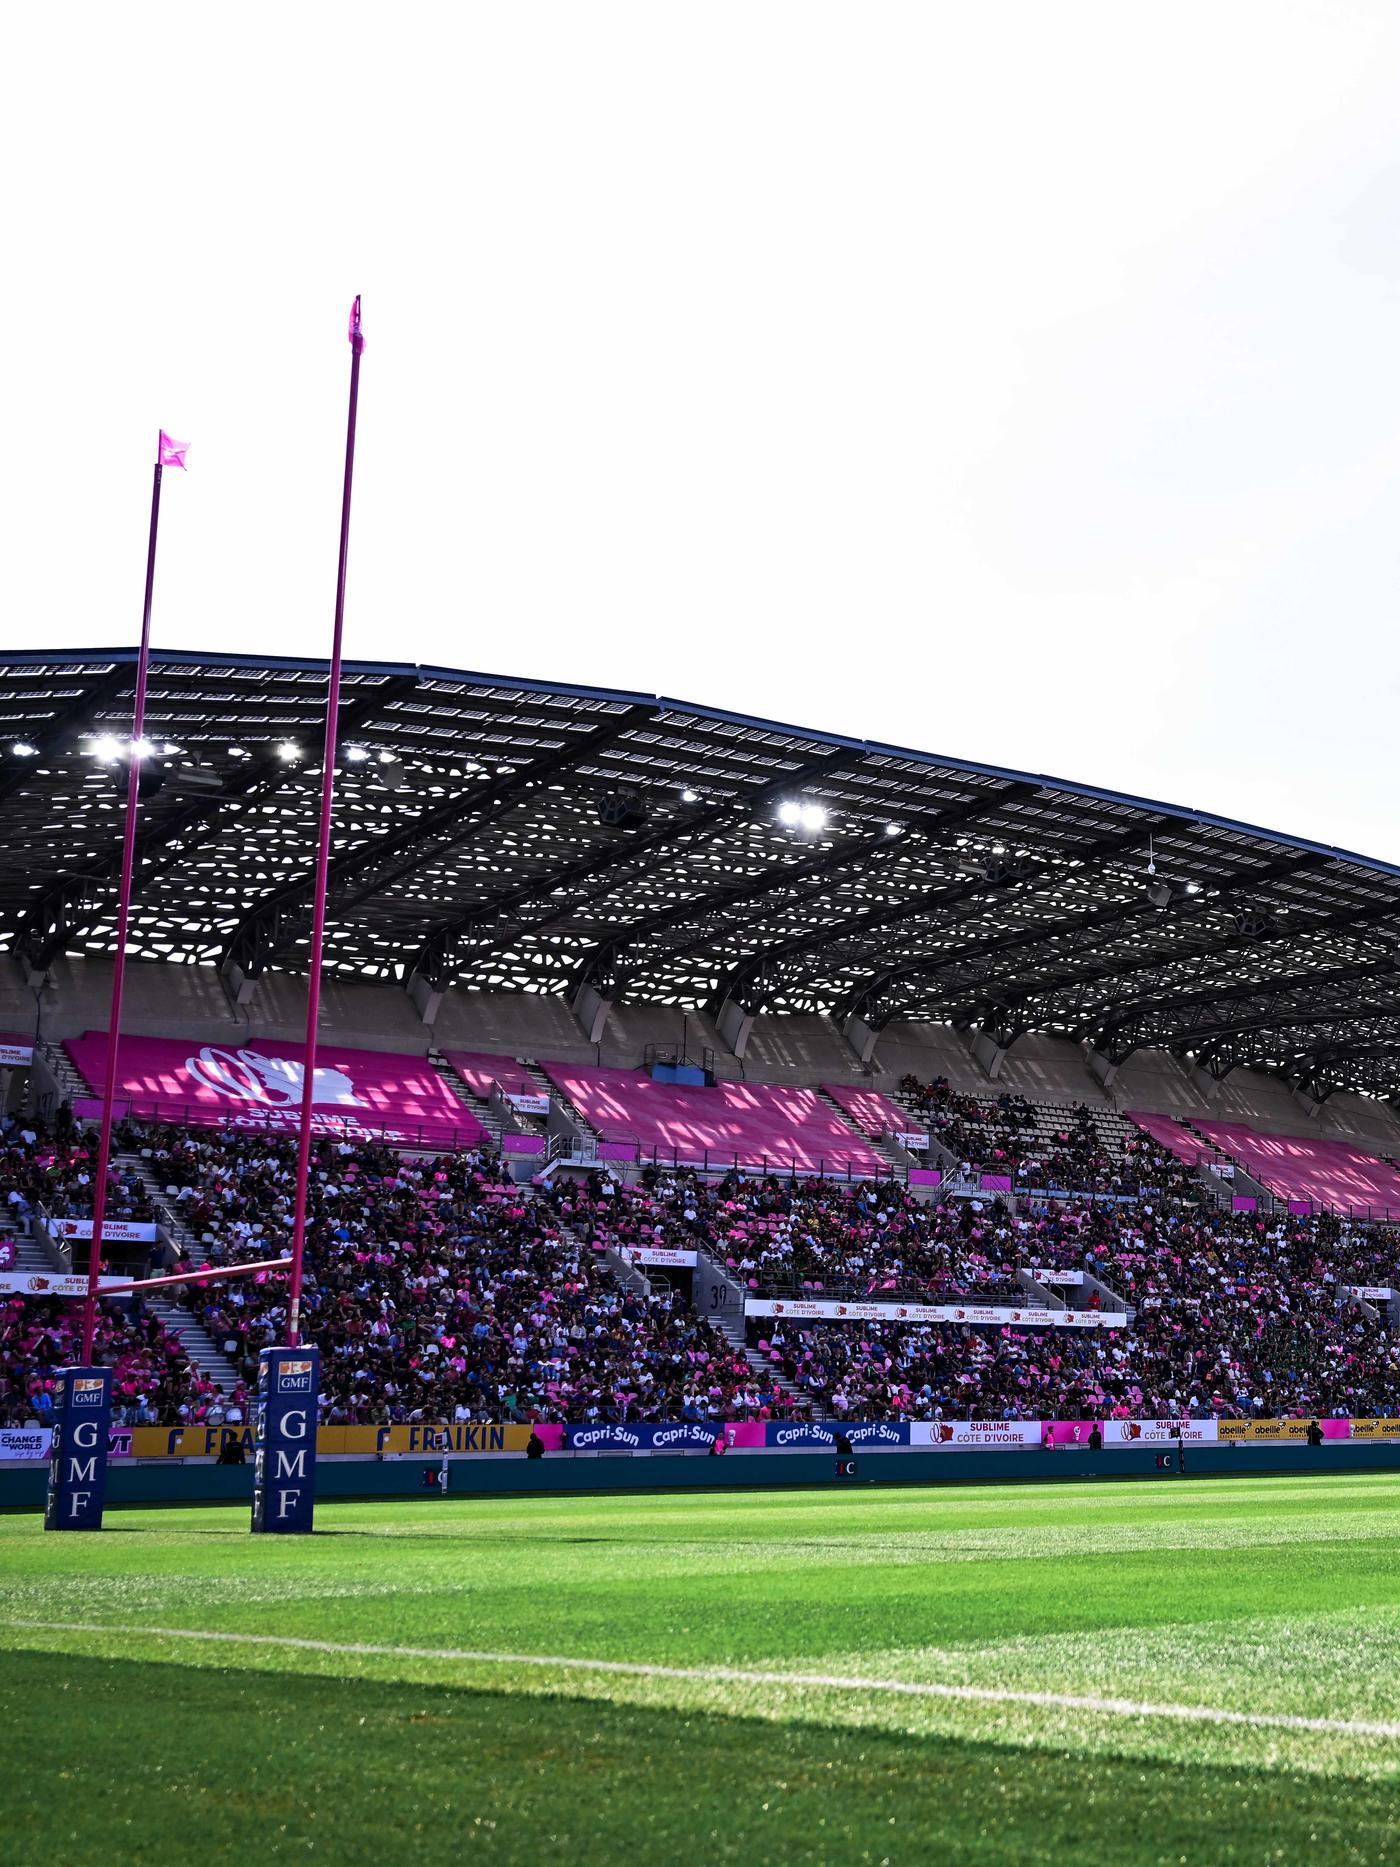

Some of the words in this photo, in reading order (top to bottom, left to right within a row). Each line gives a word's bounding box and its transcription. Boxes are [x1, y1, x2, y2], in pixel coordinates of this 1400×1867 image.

[104, 1231, 142, 1239] D'IVOIRE
[281, 1377, 310, 1389] GMF
[75, 1393, 101, 1403] GMF
[969, 1422, 1010, 1432] SUBLIME
[1155, 1421, 1191, 1429] SUBLIME
[1219, 1426, 1247, 1434] abeille
[1254, 1425, 1281, 1434] abeille
[409, 1426, 505, 1451] FRAIKIN
[573, 1425, 640, 1448] Capri-Sun
[652, 1423, 716, 1448] Capri-Sun
[776, 1423, 834, 1445] Capri-Sun
[845, 1423, 901, 1444] Capri-Sun
[956, 1431, 982, 1443] CÔTE
[984, 1433, 1024, 1443] D'IVOIRE
[1144, 1429, 1166, 1440] CÔTE
[67, 1422, 98, 1517] GMF
[274, 1410, 307, 1518] GMF
